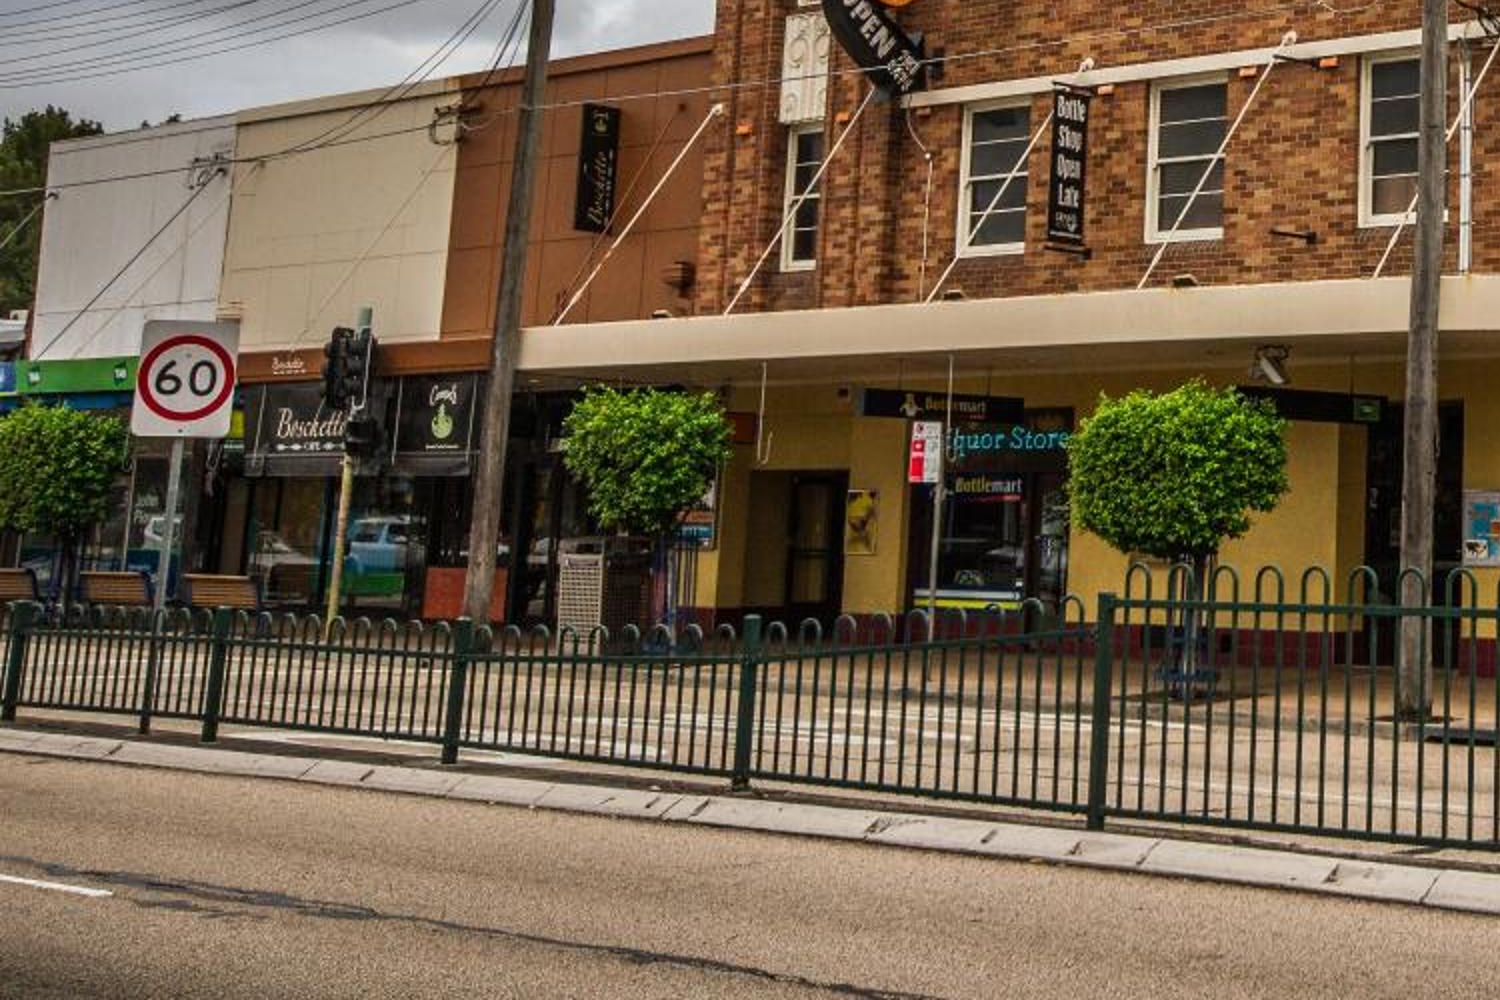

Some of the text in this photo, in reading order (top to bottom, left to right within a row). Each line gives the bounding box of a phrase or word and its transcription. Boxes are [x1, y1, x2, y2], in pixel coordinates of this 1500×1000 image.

[1057, 95, 1087, 124] Bottle
[1058, 125, 1084, 153] Shop
[1056, 153, 1082, 181] Open
[1058, 183, 1080, 209] Late
[154, 359, 217, 397] 60
[1010, 426, 1070, 450] Store
[955, 476, 1023, 495] Bottlemart
